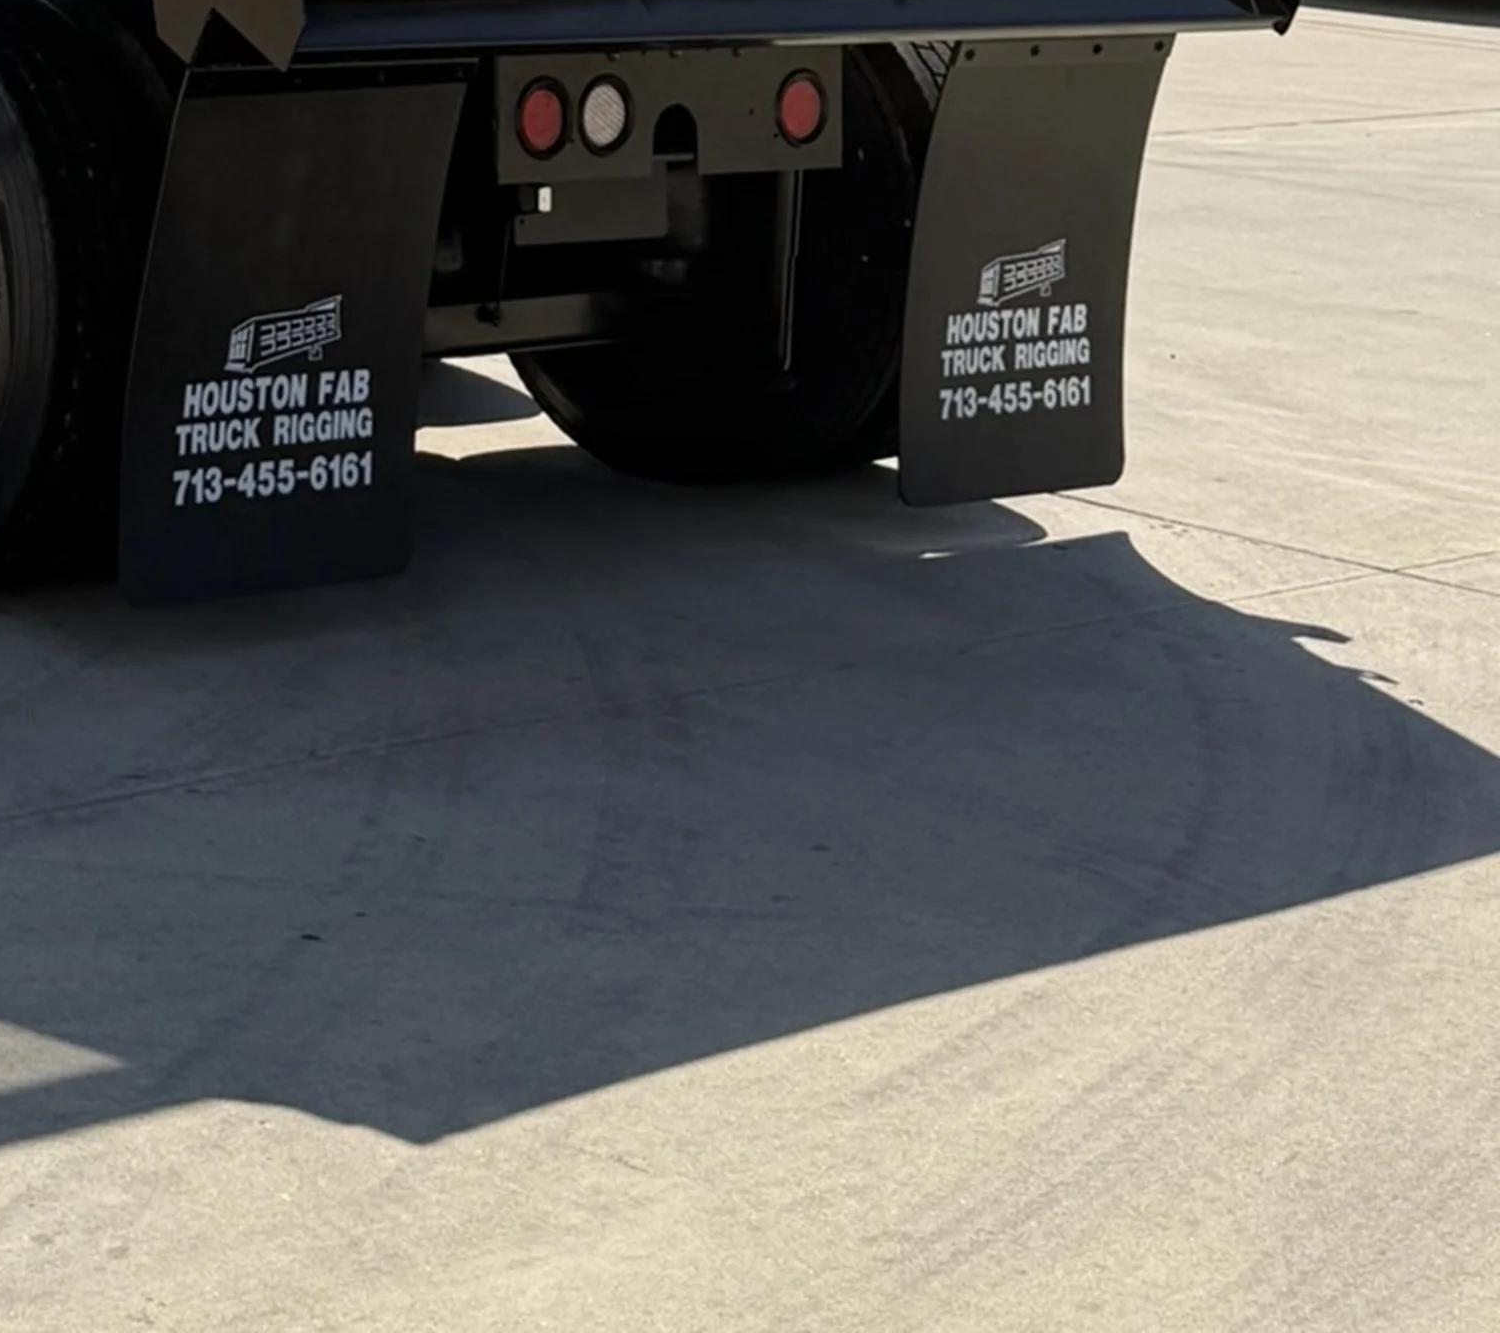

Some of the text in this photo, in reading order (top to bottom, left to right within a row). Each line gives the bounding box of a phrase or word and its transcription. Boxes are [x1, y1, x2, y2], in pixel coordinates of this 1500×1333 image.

[946, 303, 1088, 345] HOUSTON FAB
[941, 337, 1091, 377] TRUCK RIGGING
[183, 369, 371, 419] HOUSTON FAB
[940, 375, 1091, 420] 713-455-6161
[175, 408, 373, 456] TRUCK RIGGING
[173, 451, 373, 506] 713-455-6161
